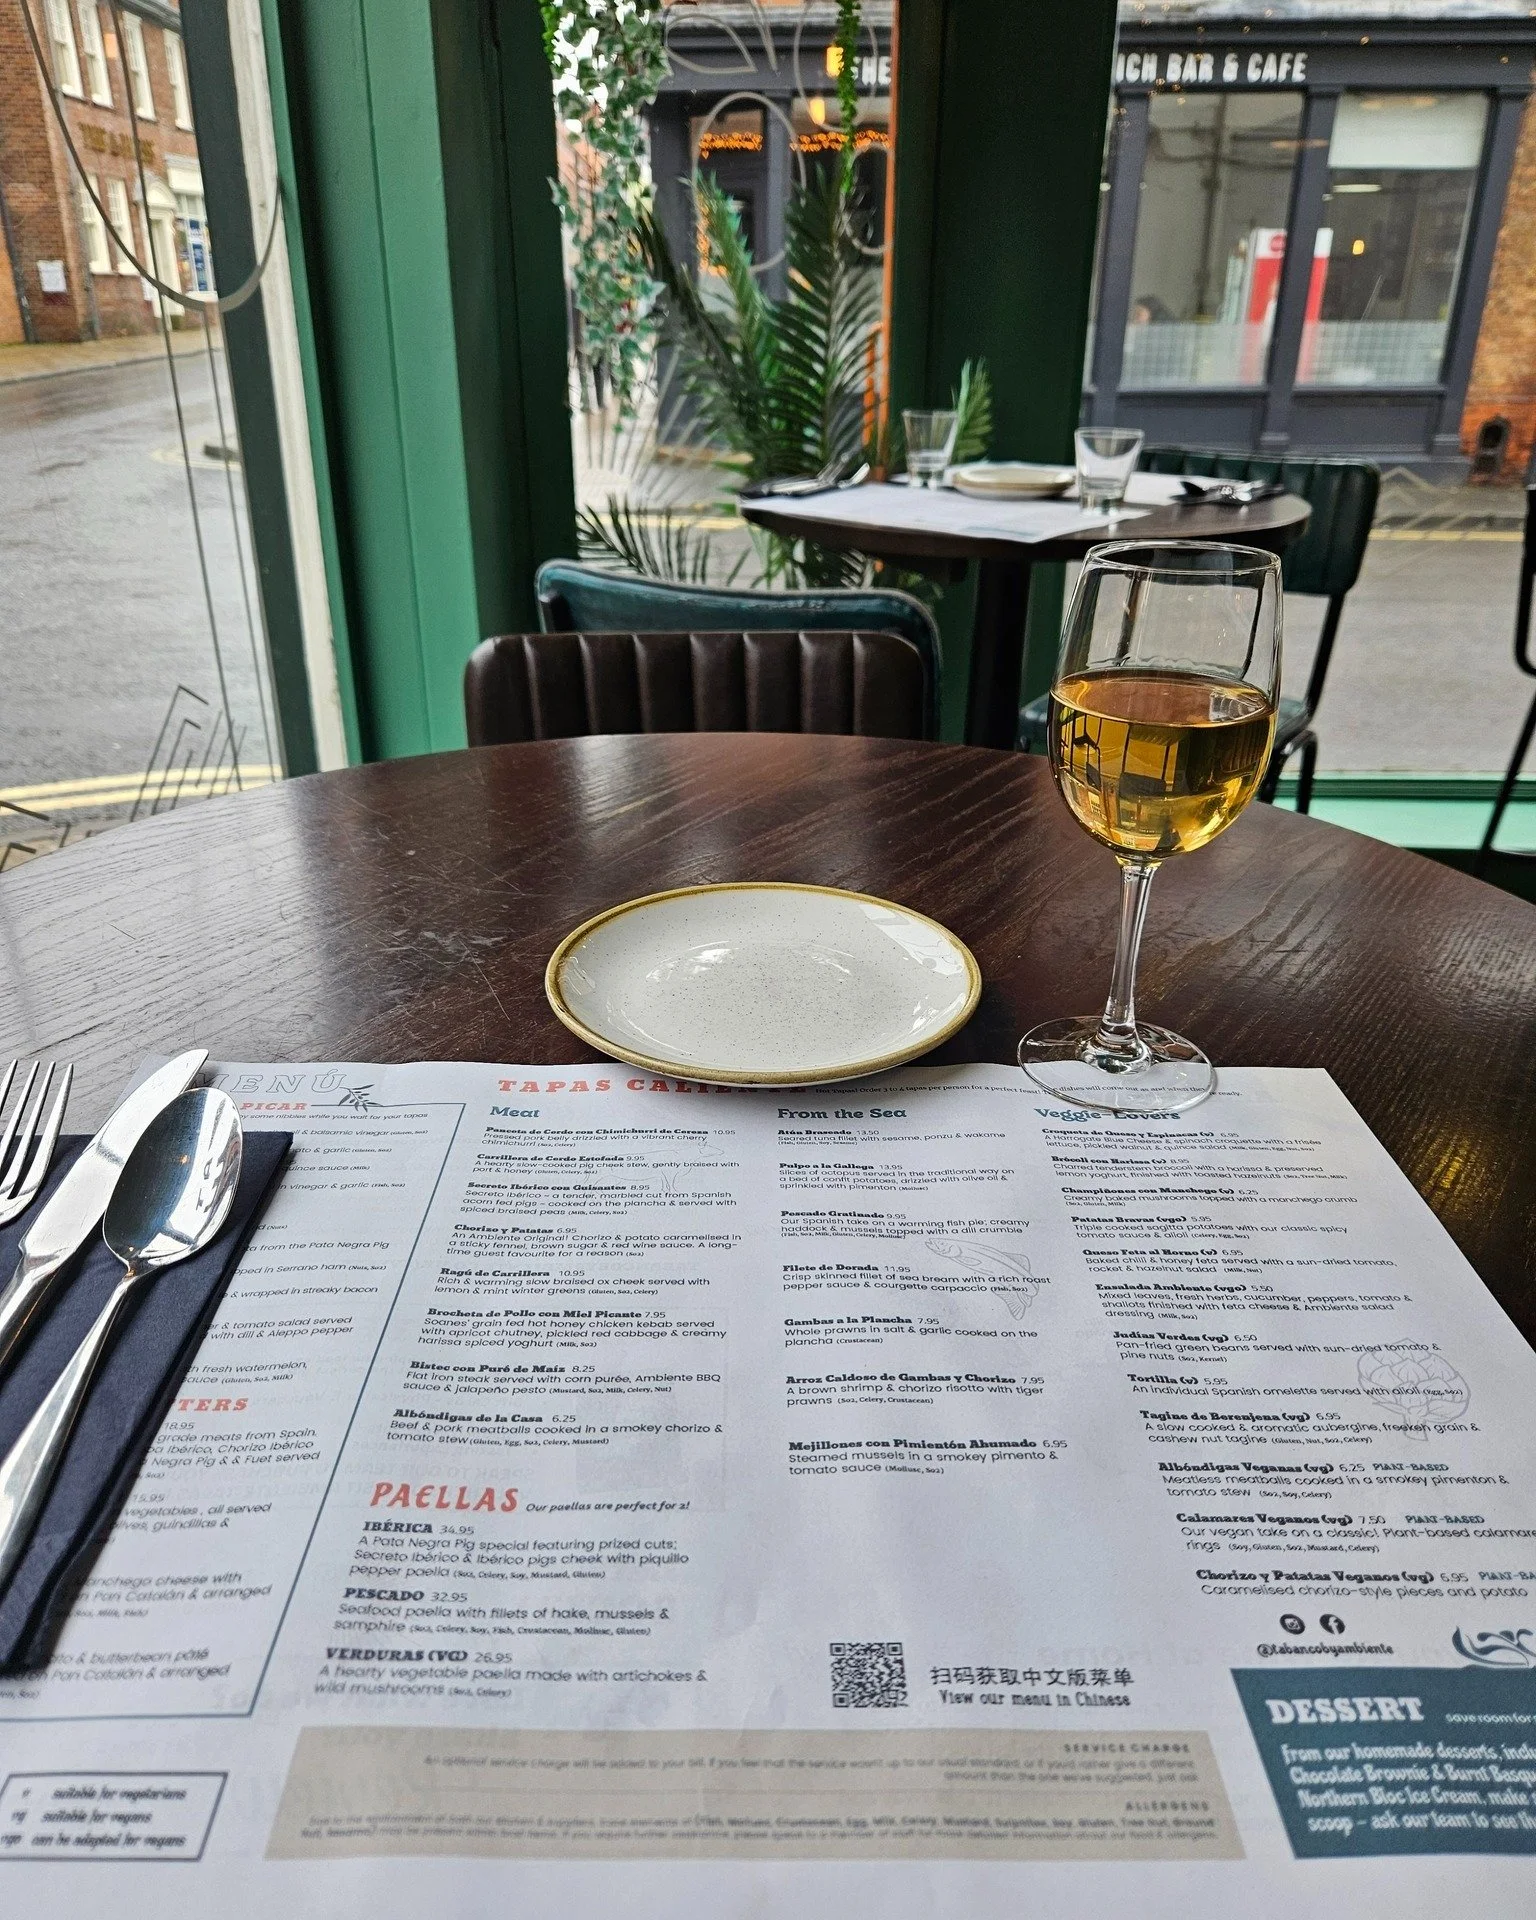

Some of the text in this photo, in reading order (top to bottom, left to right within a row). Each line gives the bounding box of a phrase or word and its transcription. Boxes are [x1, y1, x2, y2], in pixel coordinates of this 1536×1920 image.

[1166, 52, 1214, 83] BAR
[1222, 52, 1239, 83] &
[1247, 52, 1307, 83] CAFE
[499, 1080, 611, 1093] TAPAS
[239, 1102, 307, 1111] PICAR
[490, 1106, 540, 1118] Meat
[777, 1108, 907, 1119] From the Sea
[1034, 1108, 1181, 1122] Veggie-Lovers
[454, 1224, 499, 1233] Chorizo
[440, 1268, 472, 1277] Ragú
[427, 1308, 483, 1318] Brocheta
[486, 1310, 501, 1318] de
[503, 1310, 536, 1318] Pollo
[563, 1310, 592, 1318] Miel
[595, 1310, 642, 1318] Picante
[645, 1311, 666, 1319] 7.95
[784, 1318, 835, 1326] Gambas
[846, 1317, 859, 1325] la
[861, 1317, 913, 1325] Plancha
[1113, 1331, 1154, 1340] Judías
[1156, 1333, 1200, 1341] Verdes
[1202, 1334, 1229, 1343] (vg)
[409, 1361, 450, 1371] Bistec
[478, 1364, 510, 1372] Puré
[572, 1365, 595, 1373] 8.25
[786, 1376, 823, 1384] Arroz
[825, 1374, 878, 1383] Caldoso
[880, 1374, 896, 1382] de
[898, 1374, 951, 1383] Gambas
[965, 1374, 1016, 1384] Chorizo
[1022, 1377, 1045, 1385] 7.95
[1127, 1374, 1178, 1384] Tortilla
[1180, 1375, 1198, 1385] (v)
[393, 1409, 576, 1423] Albóndigas de la Casa 6.25
[1139, 1410, 1188, 1421] Tagine
[1191, 1412, 1208, 1421] de
[1209, 1412, 1279, 1423] Berenjena
[1281, 1412, 1310, 1423] (vg)
[164, 1421, 195, 1430] 18.95
[390, 1420, 419, 1430] Beef
[422, 1422, 430, 1431] &
[434, 1424, 463, 1434] pork
[467, 1424, 531, 1434] meatballs
[535, 1424, 581, 1434] cooked
[585, 1425, 596, 1433] in
[613, 1424, 662, 1434] smokey
[665, 1424, 711, 1433] chorizo
[714, 1424, 723, 1433] &
[788, 1439, 1068, 1453] Mejillones con Pimientón Ahumado 6.95
[789, 1451, 1058, 1463] Steamed mussels in a smokey pimento &
[1158, 1461, 1239, 1474] Albóndigas
[1241, 1462, 1302, 1473] Veganas
[1303, 1463, 1334, 1474] (vg)
[1339, 1463, 1365, 1472] 6.25
[370, 1482, 519, 1512] PAELLAS
[526, 1503, 548, 1512] Our
[549, 1502, 591, 1513] paellas
[614, 1500, 657, 1512] perfect
[657, 1500, 677, 1512] for
[679, 1502, 690, 1510] 2!
[1176, 1513, 1254, 1523] Calamares
[1256, 1514, 1319, 1525] Veganos
[1321, 1514, 1353, 1525] (vg)
[1358, 1515, 1386, 1524] 7.50
[362, 1519, 475, 1535] IBÉRICA 34.95
[1196, 1569, 1257, 1581] Chorizo
[1259, 1573, 1270, 1583] y
[1271, 1570, 1331, 1581] Patatas
[1333, 1571, 1399, 1582] Veganos
[1401, 1571, 1434, 1584] (vg)
[1440, 1573, 1469, 1582] 6.95
[343, 1587, 467, 1603] PESCADO 32.95
[326, 1647, 424, 1662] VERDURAS
[475, 1653, 512, 1664] 26.95
[1257, 1643, 1394, 1658] @tabancobyambiente
[930, 1666, 1135, 1687] 扫码获取中文版菜单
[939, 1690, 1131, 1707] View our menu in Chinese
[1265, 1697, 1424, 1724] DESSERT
[1324, 1747, 1351, 1761] our
[1352, 1742, 1434, 1760] homemade
[1437, 1742, 1503, 1762] desserts,
[1291, 1766, 1363, 1785] Chocolate
[1363, 1764, 1430, 1781] Brownie
[1431, 1764, 1446, 1780] &
[1446, 1765, 1488, 1781] Burnt
[1297, 1787, 1529, 1808] Northern Bloc Ice Cream, make
